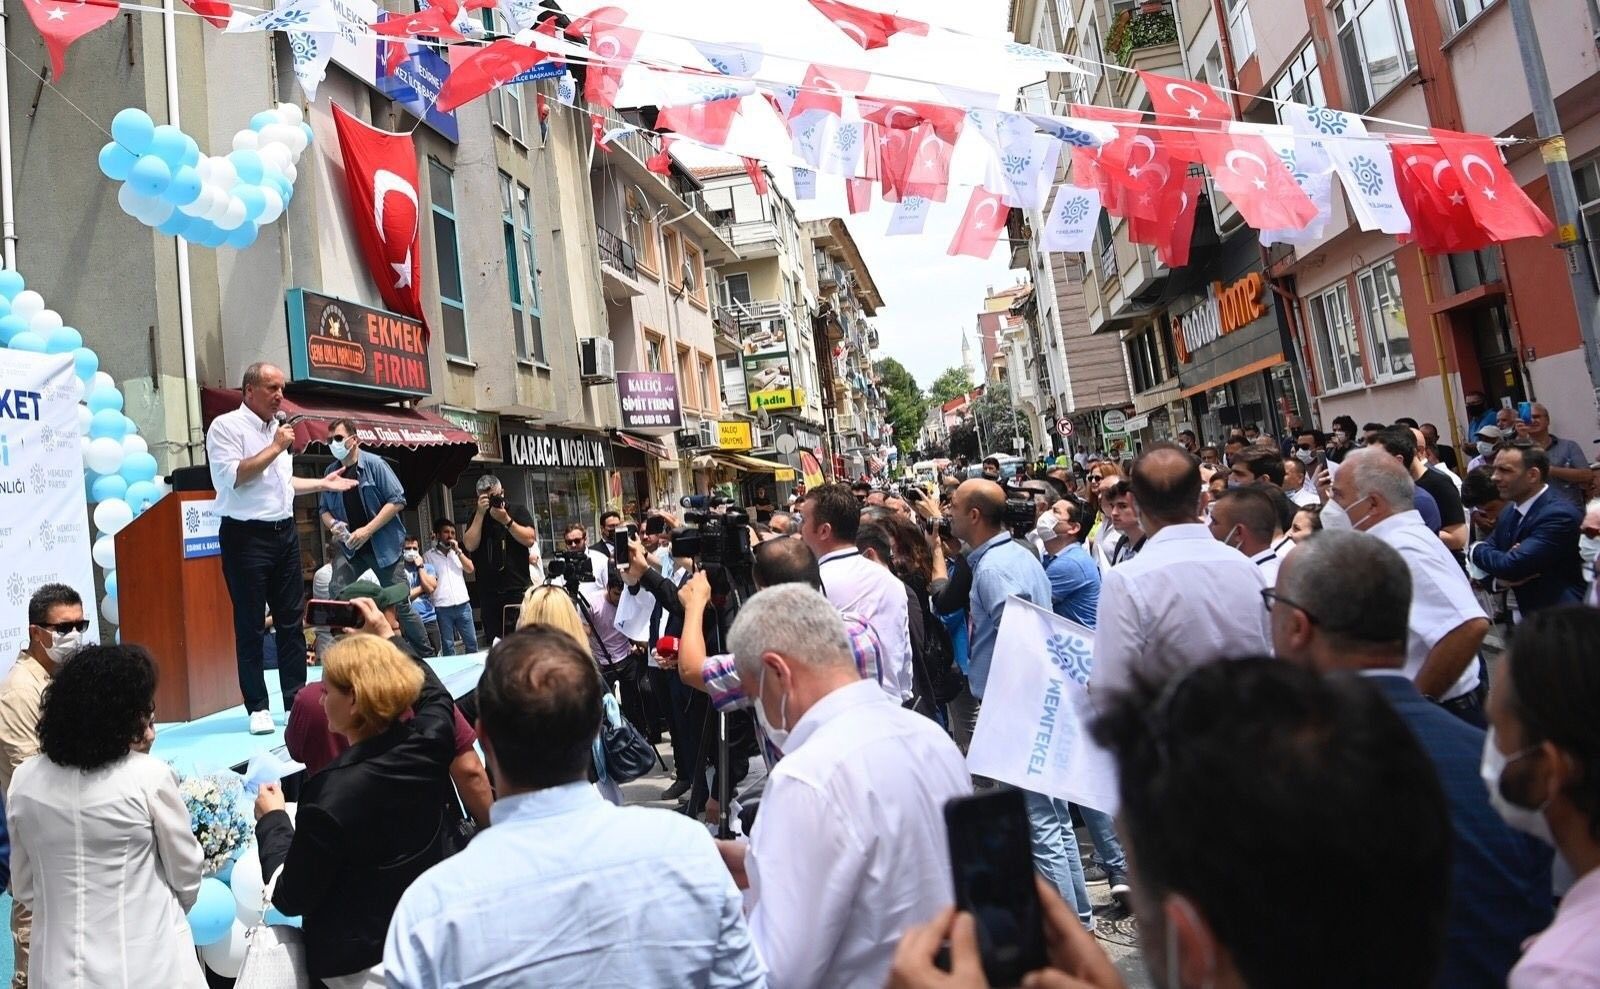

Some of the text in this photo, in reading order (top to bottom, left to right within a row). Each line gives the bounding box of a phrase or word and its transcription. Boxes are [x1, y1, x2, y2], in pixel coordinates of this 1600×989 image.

[366, 312, 425, 356] EKMEK
[373, 351, 427, 390] FIRINI
[0, 388, 41, 421] KET
[355, 428, 377, 441] ena
[509, 433, 559, 466] KARACA
[561, 434, 605, 467] MOBİLYA
[0, 478, 26, 494] NLIĞI
[0, 627, 21, 641] LEKET
